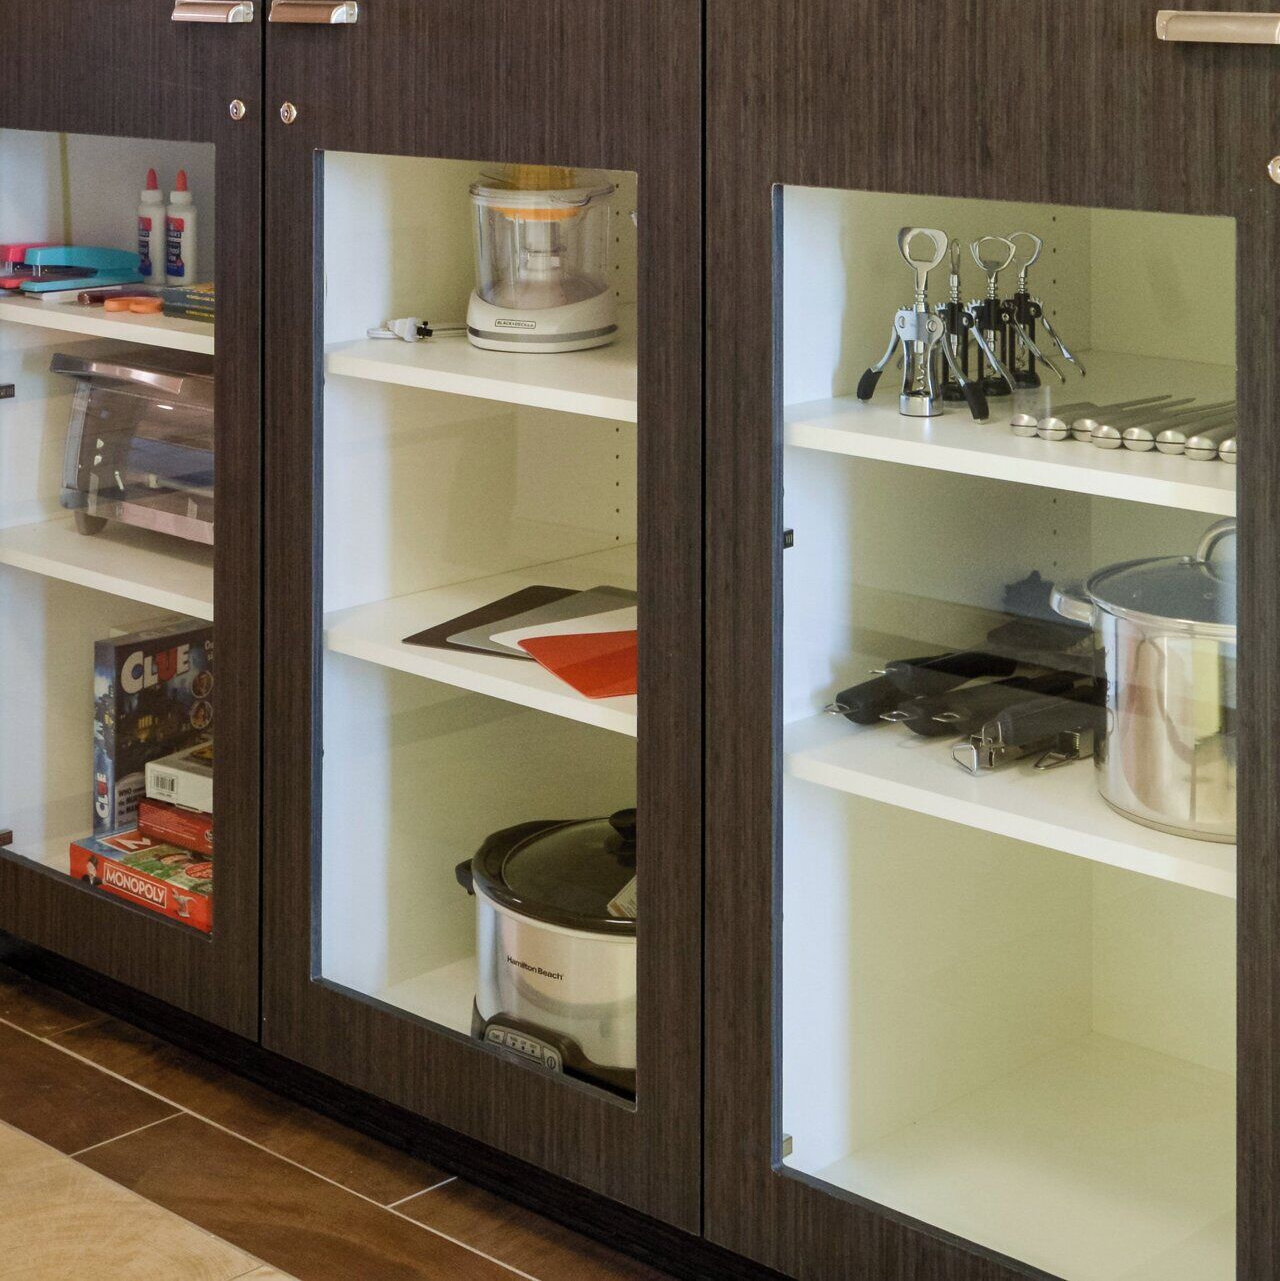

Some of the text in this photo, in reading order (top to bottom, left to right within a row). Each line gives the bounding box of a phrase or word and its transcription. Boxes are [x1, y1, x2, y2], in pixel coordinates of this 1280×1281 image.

[120, 643, 190, 695] CLUE
[106, 867, 165, 903] MONOPOLY
[506, 954, 563, 981] Hamilton Beach
